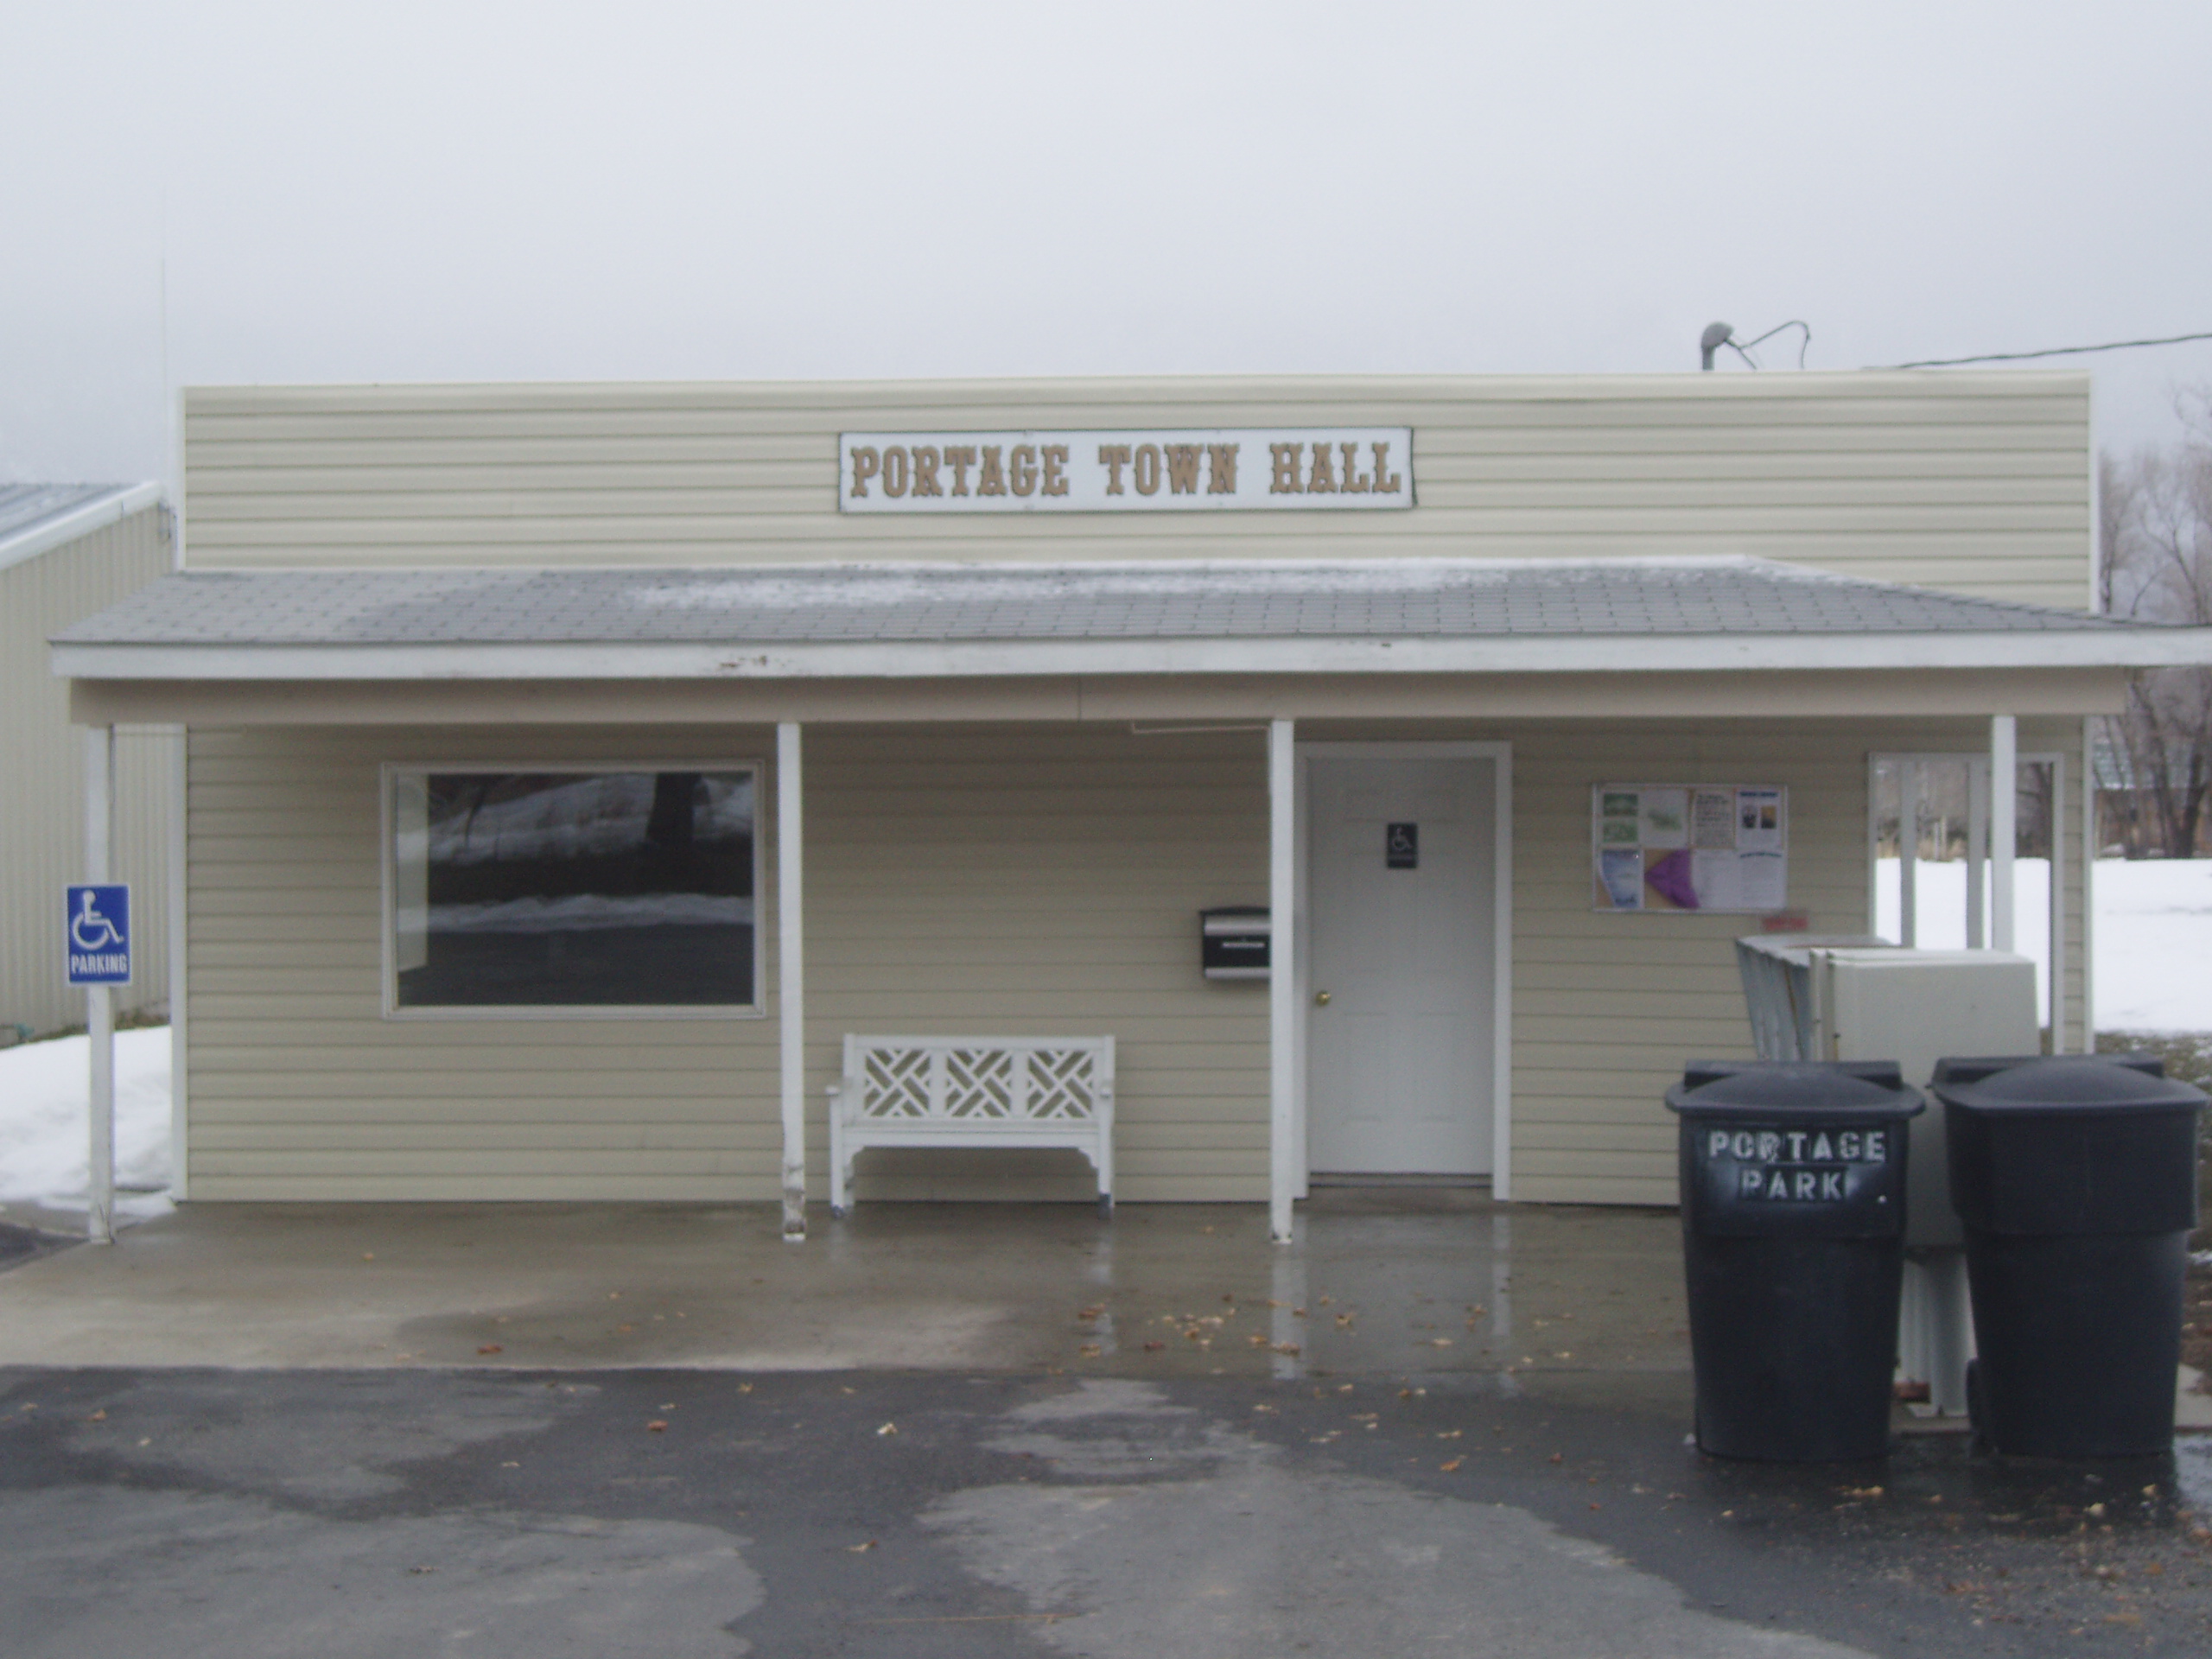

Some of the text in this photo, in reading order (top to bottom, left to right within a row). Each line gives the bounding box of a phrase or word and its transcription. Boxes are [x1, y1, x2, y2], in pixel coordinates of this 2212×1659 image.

[850, 442, 1402, 498] PORTAGE TOWN HALL
[71, 953, 128, 974] PARKING
[1708, 1130, 1886, 1163] PORTAGE
[1741, 1169, 1843, 1201] PARK
